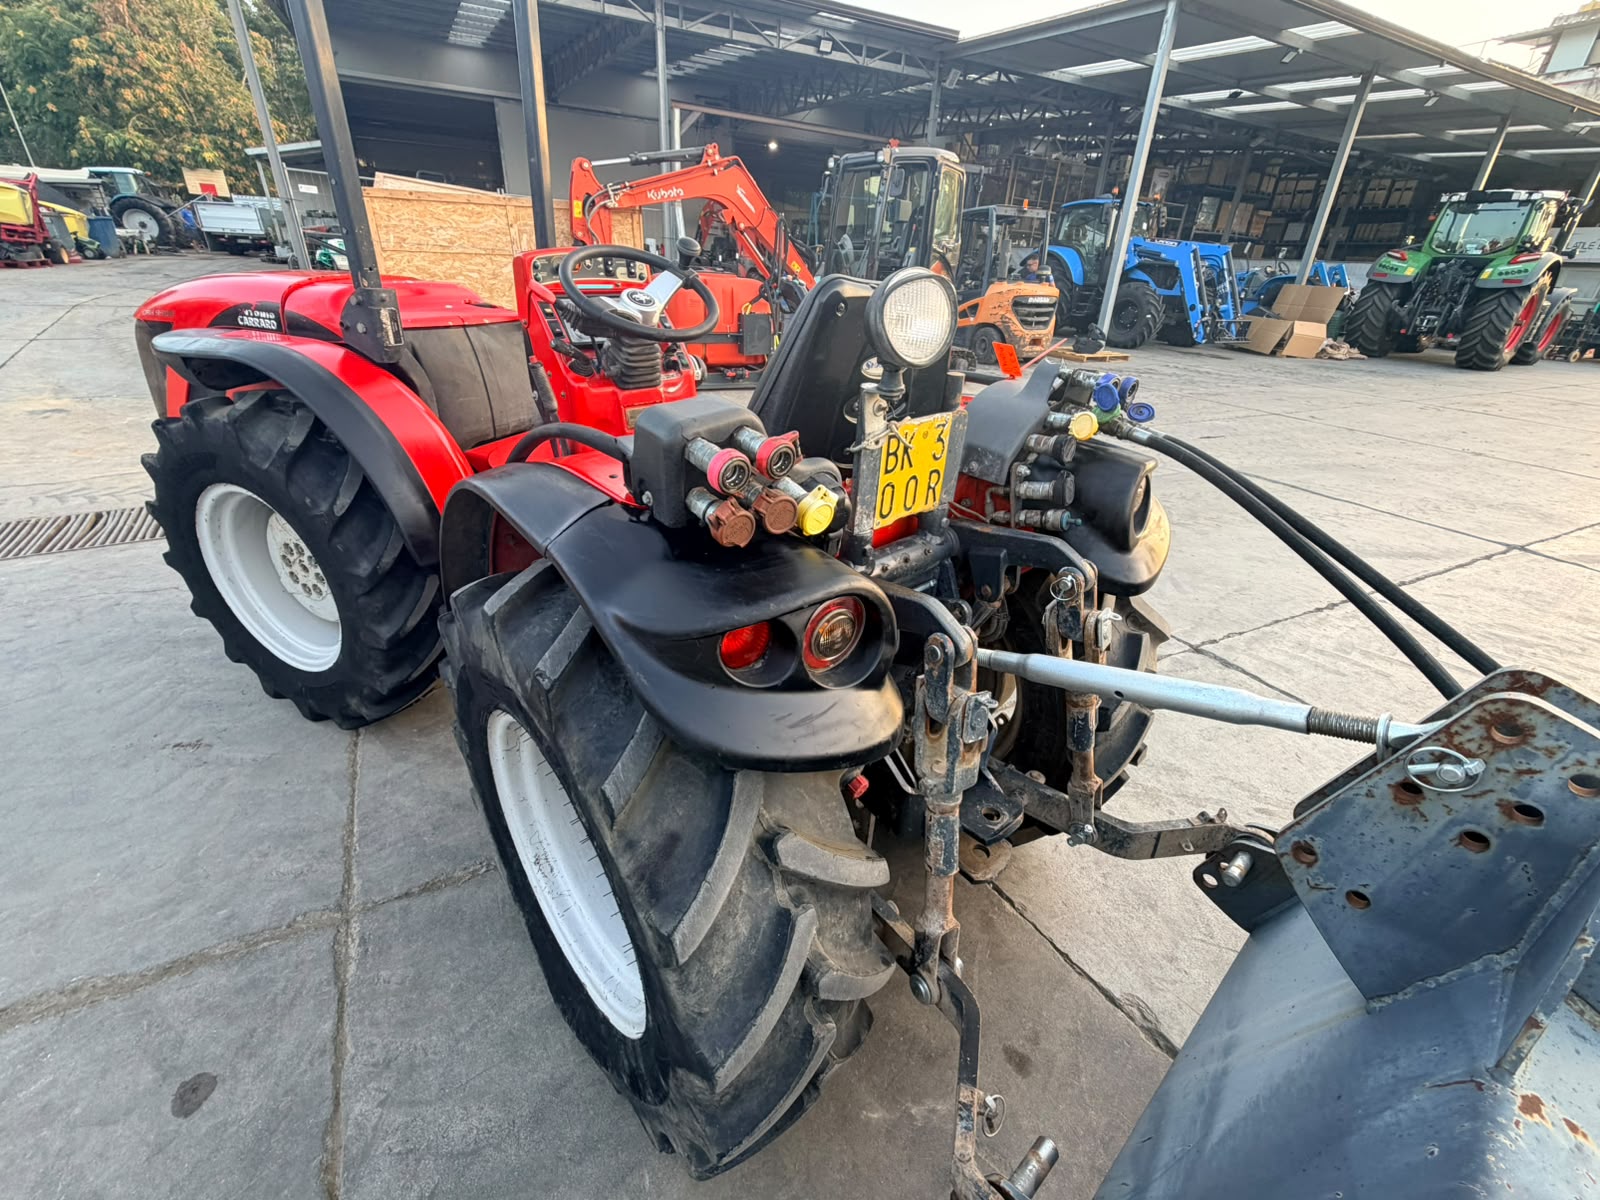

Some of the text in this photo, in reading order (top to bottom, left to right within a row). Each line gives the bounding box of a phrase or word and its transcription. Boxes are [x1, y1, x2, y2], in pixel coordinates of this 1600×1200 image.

[647, 186, 684, 200] Kubota
[237, 315, 277, 330] CARRARO
[884, 421, 948, 474] BK 3
